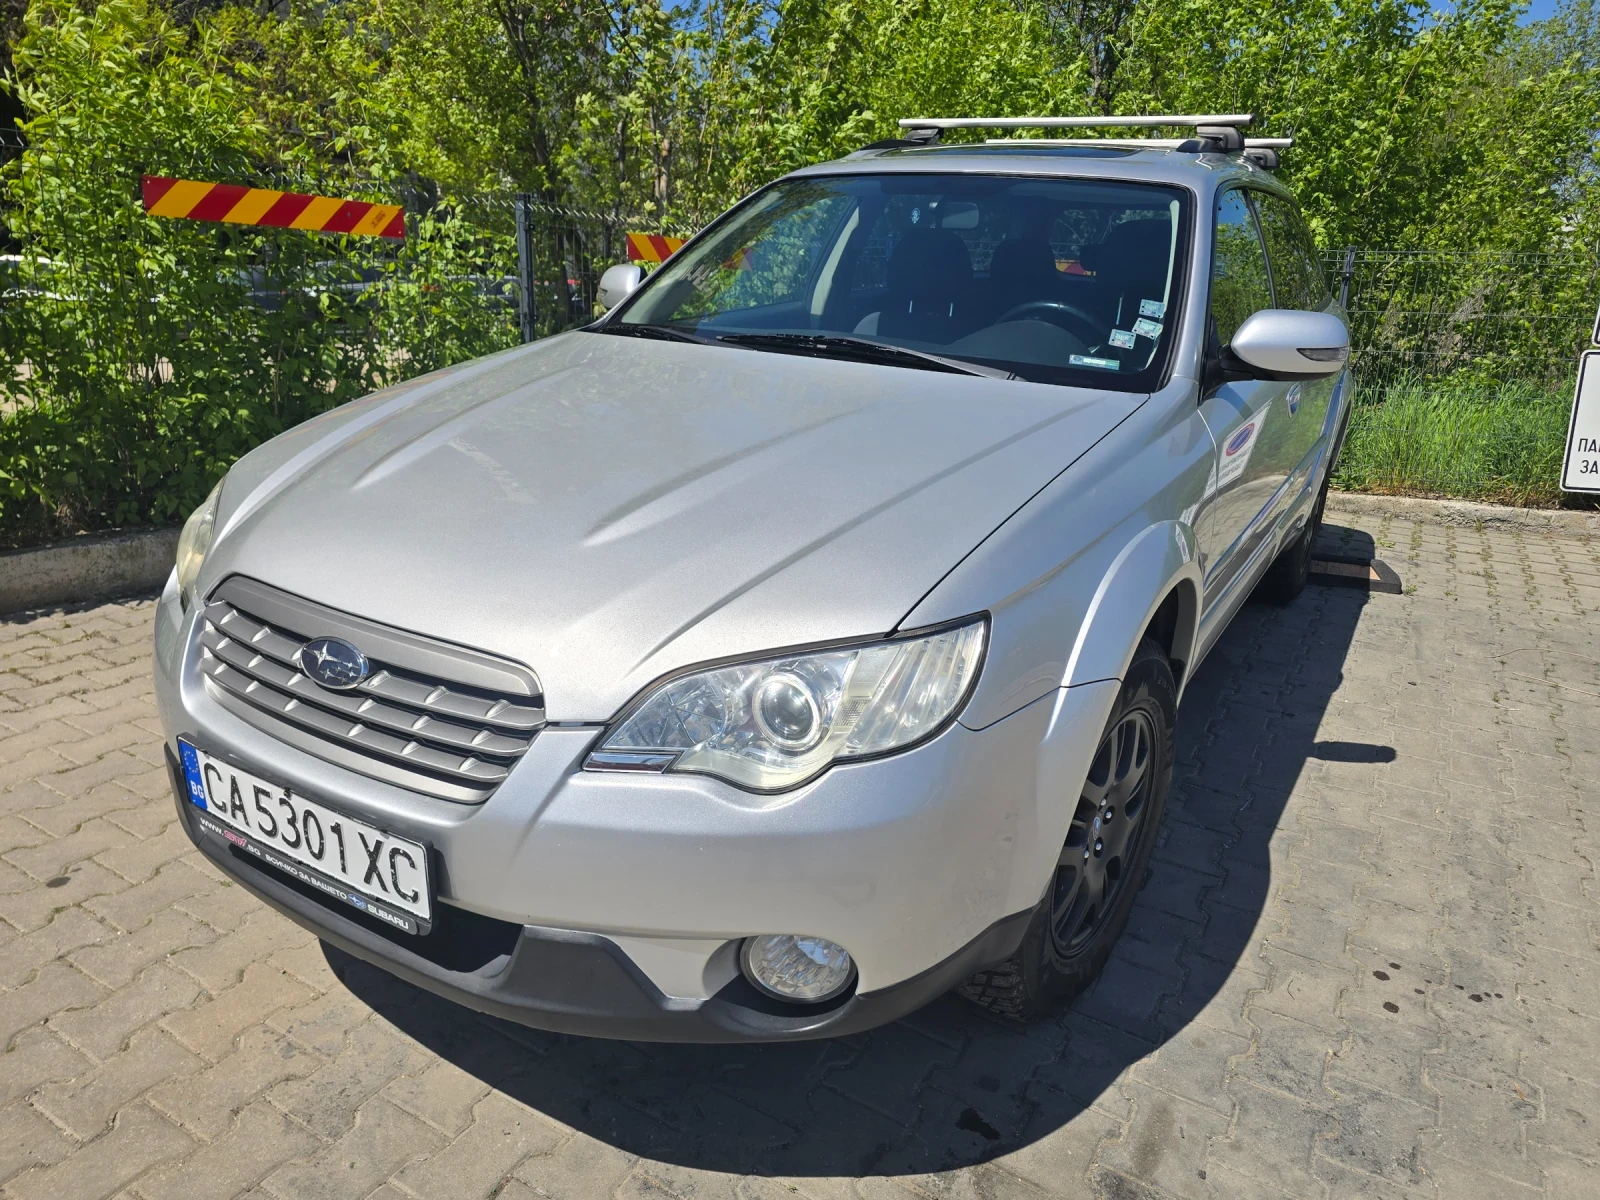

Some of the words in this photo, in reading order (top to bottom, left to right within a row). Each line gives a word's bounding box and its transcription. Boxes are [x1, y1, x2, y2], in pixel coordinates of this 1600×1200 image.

[190, 780, 205, 799] BG
[264, 853, 298, 875] ВСИЧКО
[298, 870, 311, 883] ЗА
[310, 877, 348, 900] ВАШЕТО
[367, 903, 409, 930] SUBARU
